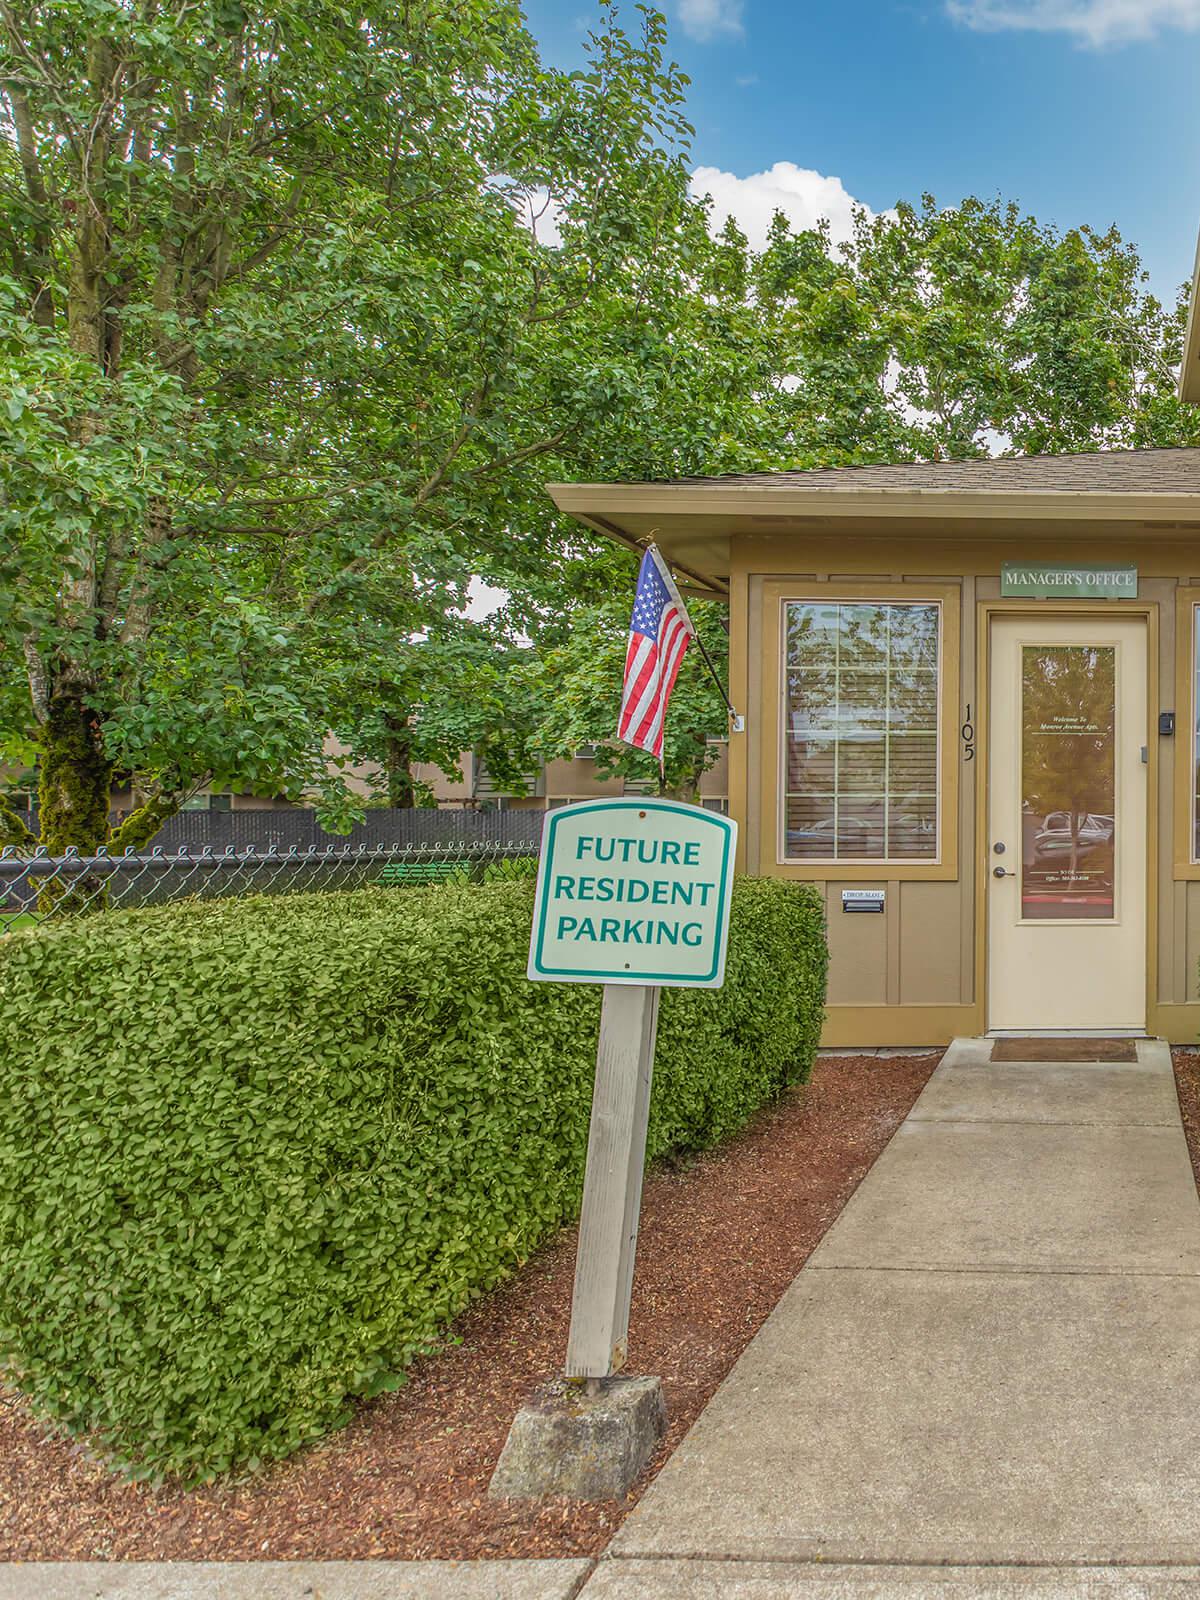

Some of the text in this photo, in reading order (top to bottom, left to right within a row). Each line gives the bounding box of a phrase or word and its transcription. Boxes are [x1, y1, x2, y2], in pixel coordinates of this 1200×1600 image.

[1005, 572, 1134, 586] MANAGER'S OFFICE
[962, 703, 974, 761] 105
[575, 836, 701, 866] FUTURE
[554, 875, 715, 906] RESIDENT
[556, 916, 703, 947] PARKING
